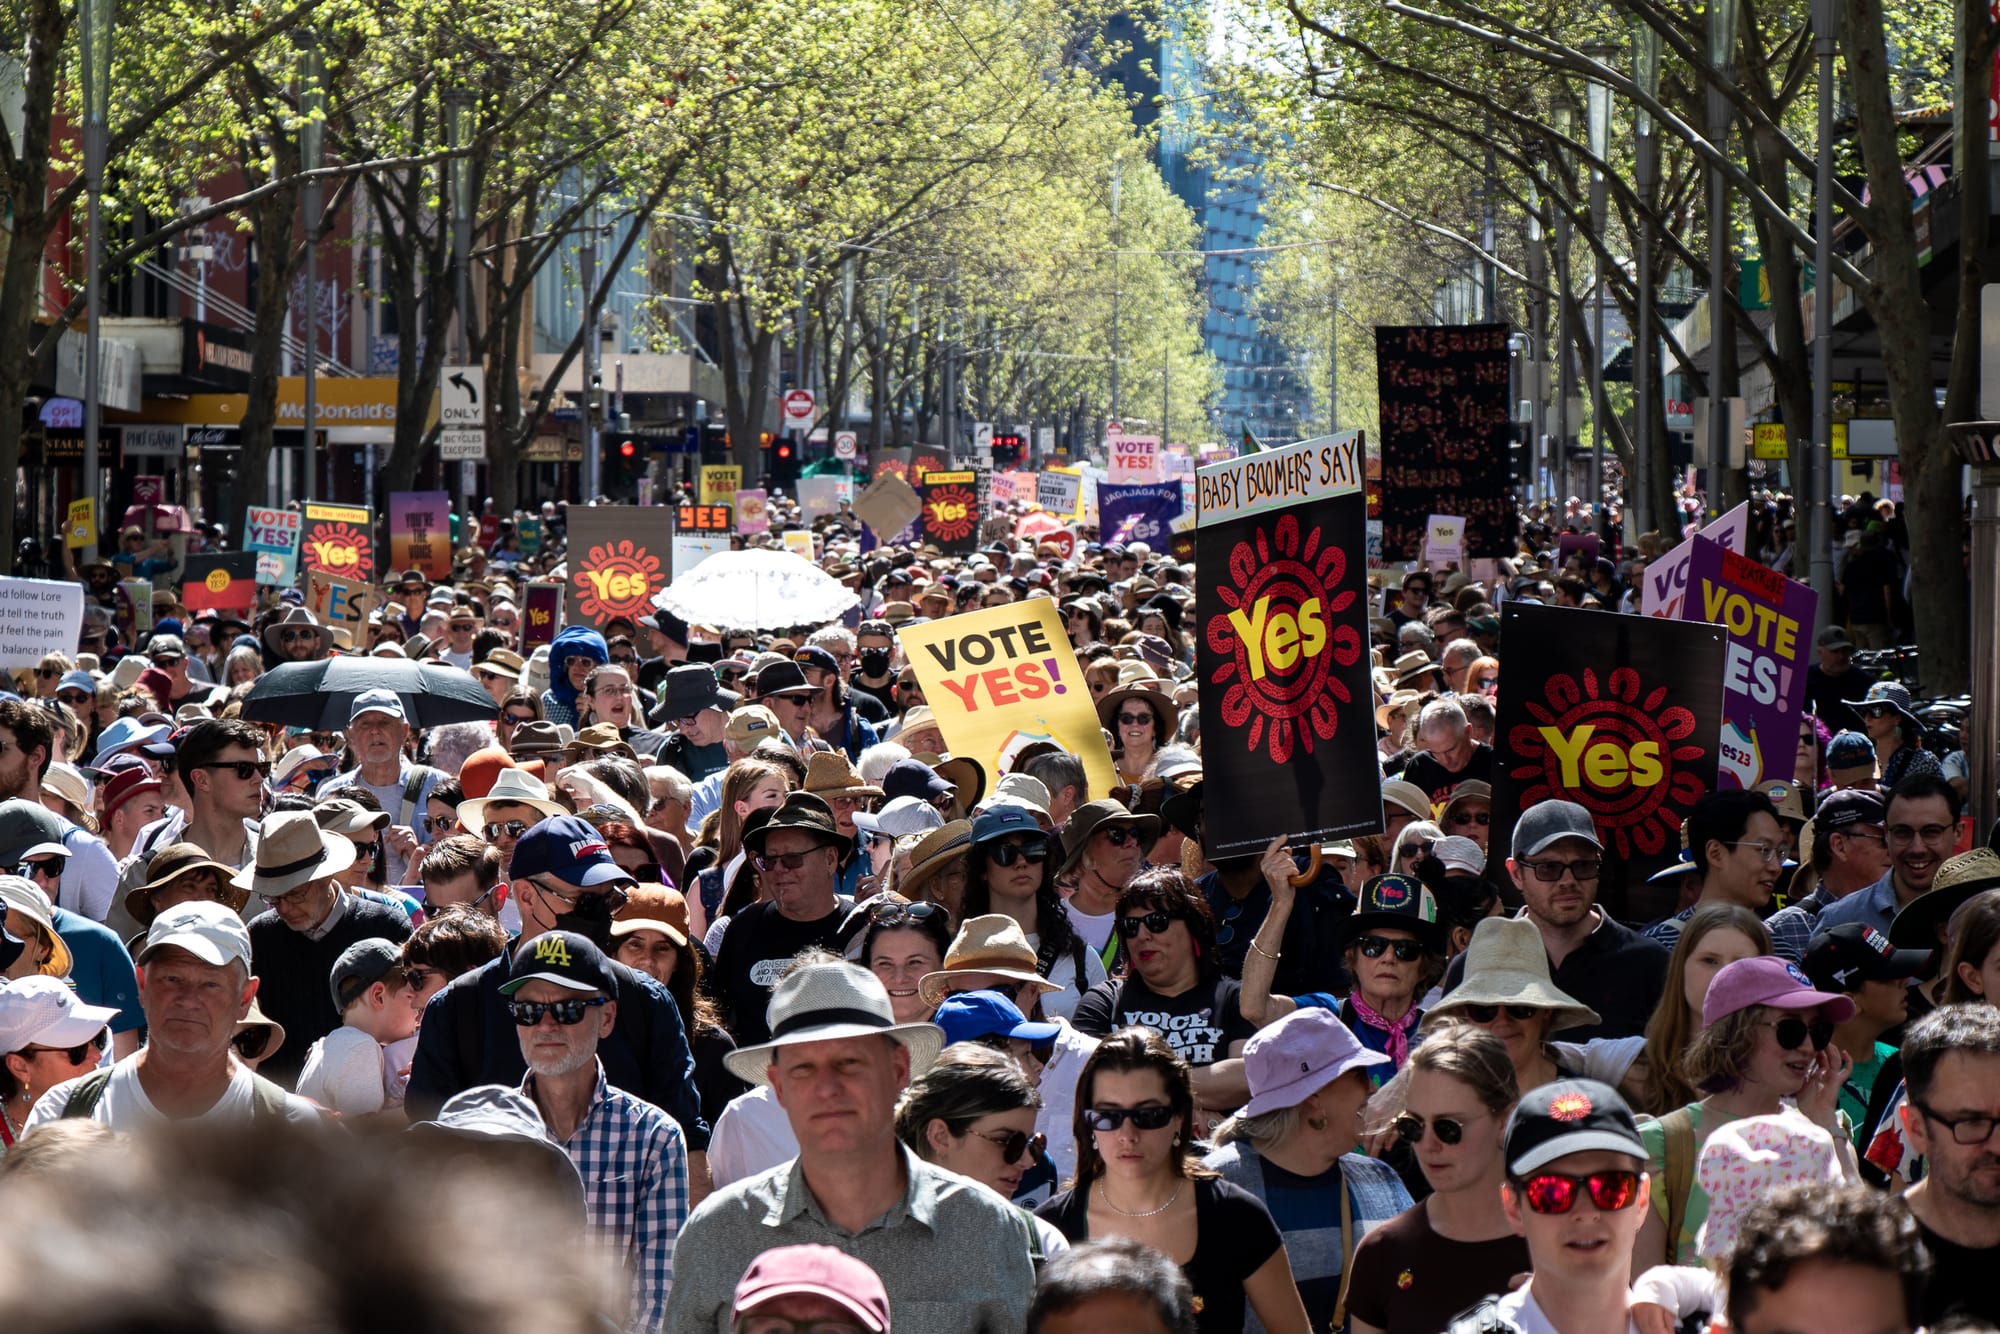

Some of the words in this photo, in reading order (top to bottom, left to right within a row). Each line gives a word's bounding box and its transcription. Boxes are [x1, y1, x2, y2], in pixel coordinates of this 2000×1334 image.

[443, 408, 481, 419] ONLY
[444, 434, 482, 444] BICYCLES
[1116, 442, 1155, 454] VOTE
[1115, 455, 1153, 469] YES!
[707, 471, 737, 480] VOTE
[992, 476, 1015, 489] VOTE
[1201, 467, 1242, 512] BABY
[1245, 449, 1313, 505] BOOMERS
[1319, 438, 1357, 487] SAY
[706, 481, 737, 492] YES!
[1040, 494, 1057, 507] VOTE
[1104, 488, 1156, 505] JAGAJAGA
[1157, 488, 1177, 502] FOR
[249, 508, 298, 529] VOTE
[404, 512, 435, 528] YOU'RE
[680, 506, 727, 528] YES
[930, 501, 967, 523] Yes
[248, 525, 297, 547] YES!
[1437, 527, 1454, 537] Yes
[311, 541, 360, 567] Yes
[586, 568, 648, 601] Yes
[11, 589, 39, 601] follow
[41, 591, 62, 602] Lore
[311, 577, 368, 623] YES
[7, 608, 22, 618] tell
[24, 609, 39, 620] the
[41, 610, 65, 620] truth
[529, 608, 550, 626] Yes
[1702, 578, 1800, 661] VOTE
[6, 625, 24, 637] feel
[27, 626, 42, 637] the
[43, 627, 64, 640] pain
[1227, 595, 1327, 681] Yes
[2, 643, 39, 655] balance
[41, 645, 47, 655] it
[924, 620, 1052, 672] VOTE
[940, 657, 1067, 713] YES!
[1724, 639, 1793, 714] ES!
[1537, 724, 1664, 789] Yes
[1381, 885, 1404, 899] Yes
[534, 932, 572, 967] WA
[1123, 1010, 1209, 1031] VOICE
